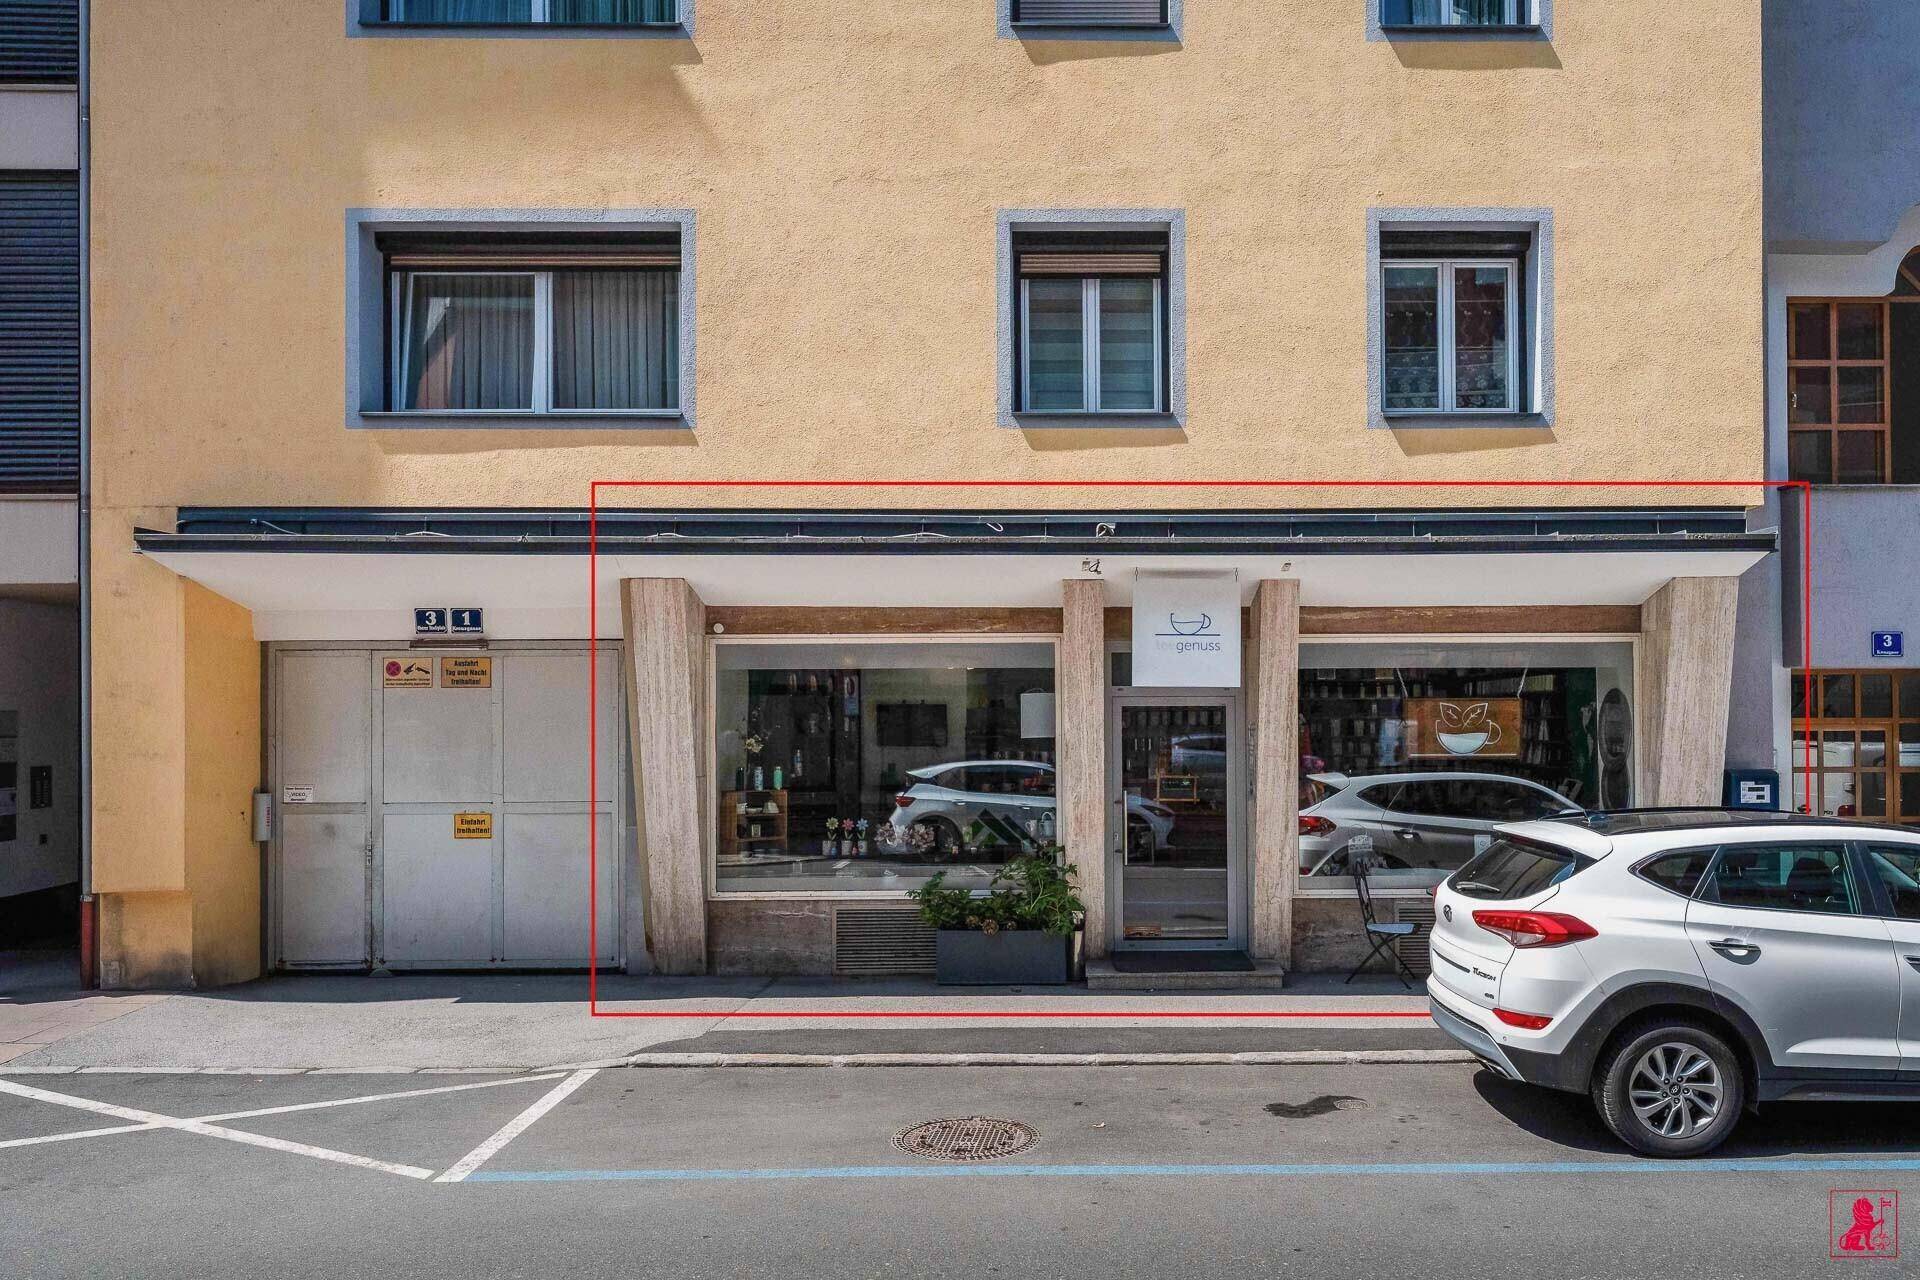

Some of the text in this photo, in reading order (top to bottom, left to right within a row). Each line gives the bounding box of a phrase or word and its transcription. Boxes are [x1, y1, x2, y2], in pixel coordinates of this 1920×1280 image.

[425, 611, 437, 626] 3
[461, 611, 470, 626] 1
[1883, 634, 1893, 647] 3
